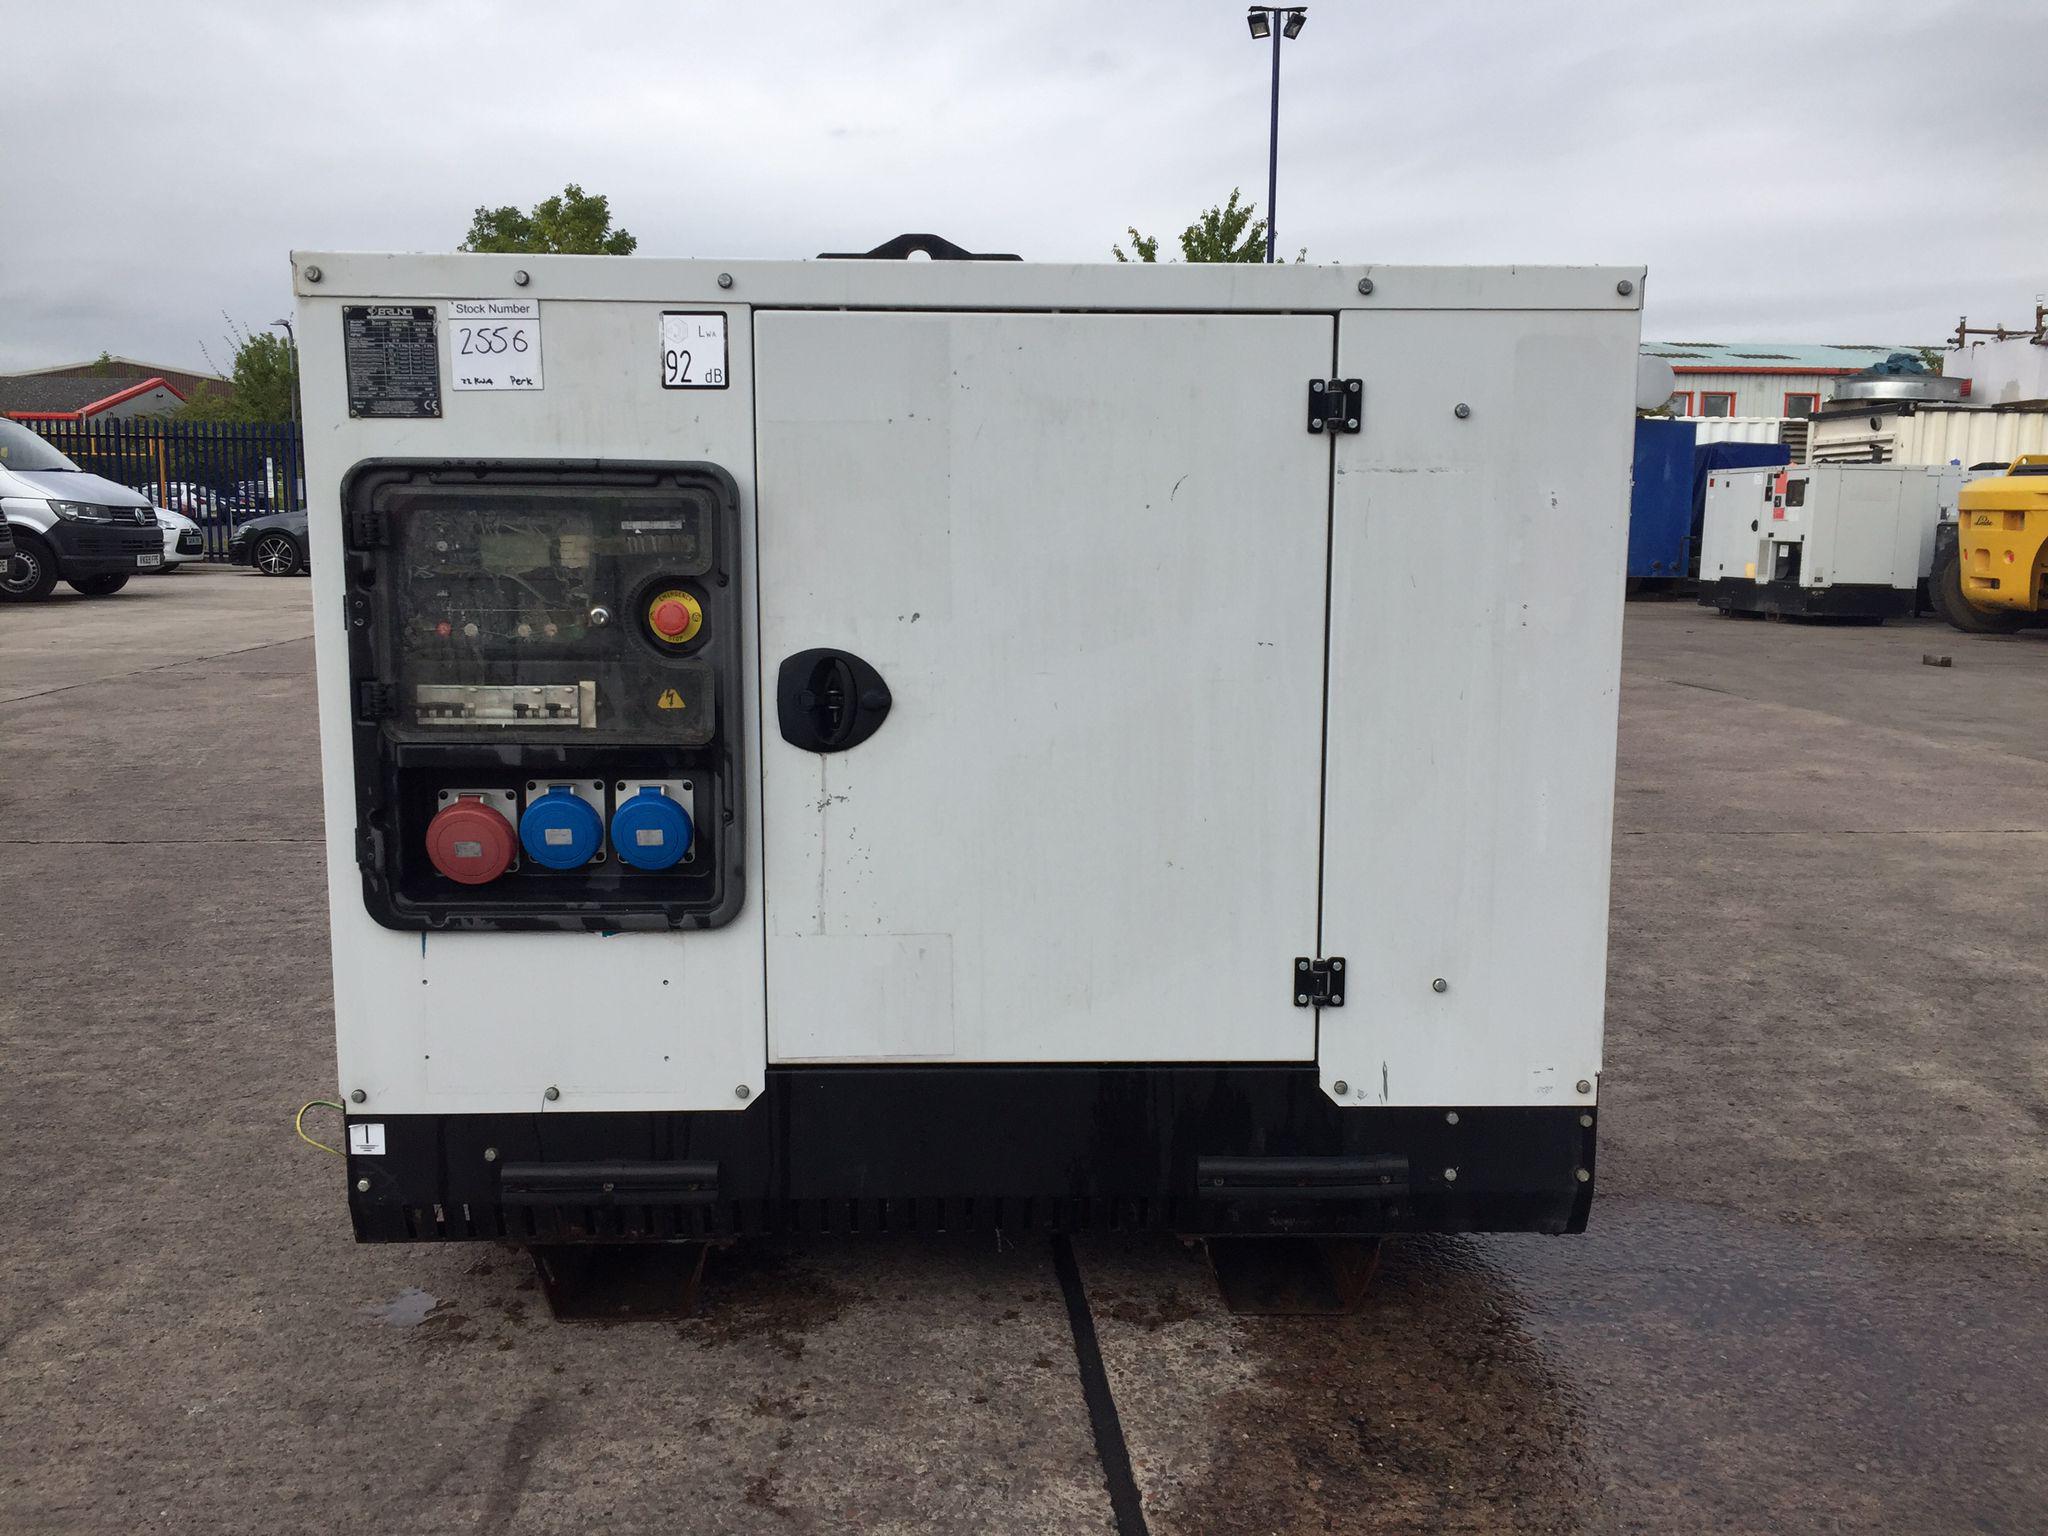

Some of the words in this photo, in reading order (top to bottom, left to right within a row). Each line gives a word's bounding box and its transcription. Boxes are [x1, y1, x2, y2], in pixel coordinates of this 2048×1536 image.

[378, 308, 413, 316] BRUNO
[456, 304, 486, 314] Stock
[488, 304, 531, 314] Number
[460, 326, 529, 355] 2556
[666, 350, 692, 383] 92
[705, 368, 723, 384] dB
